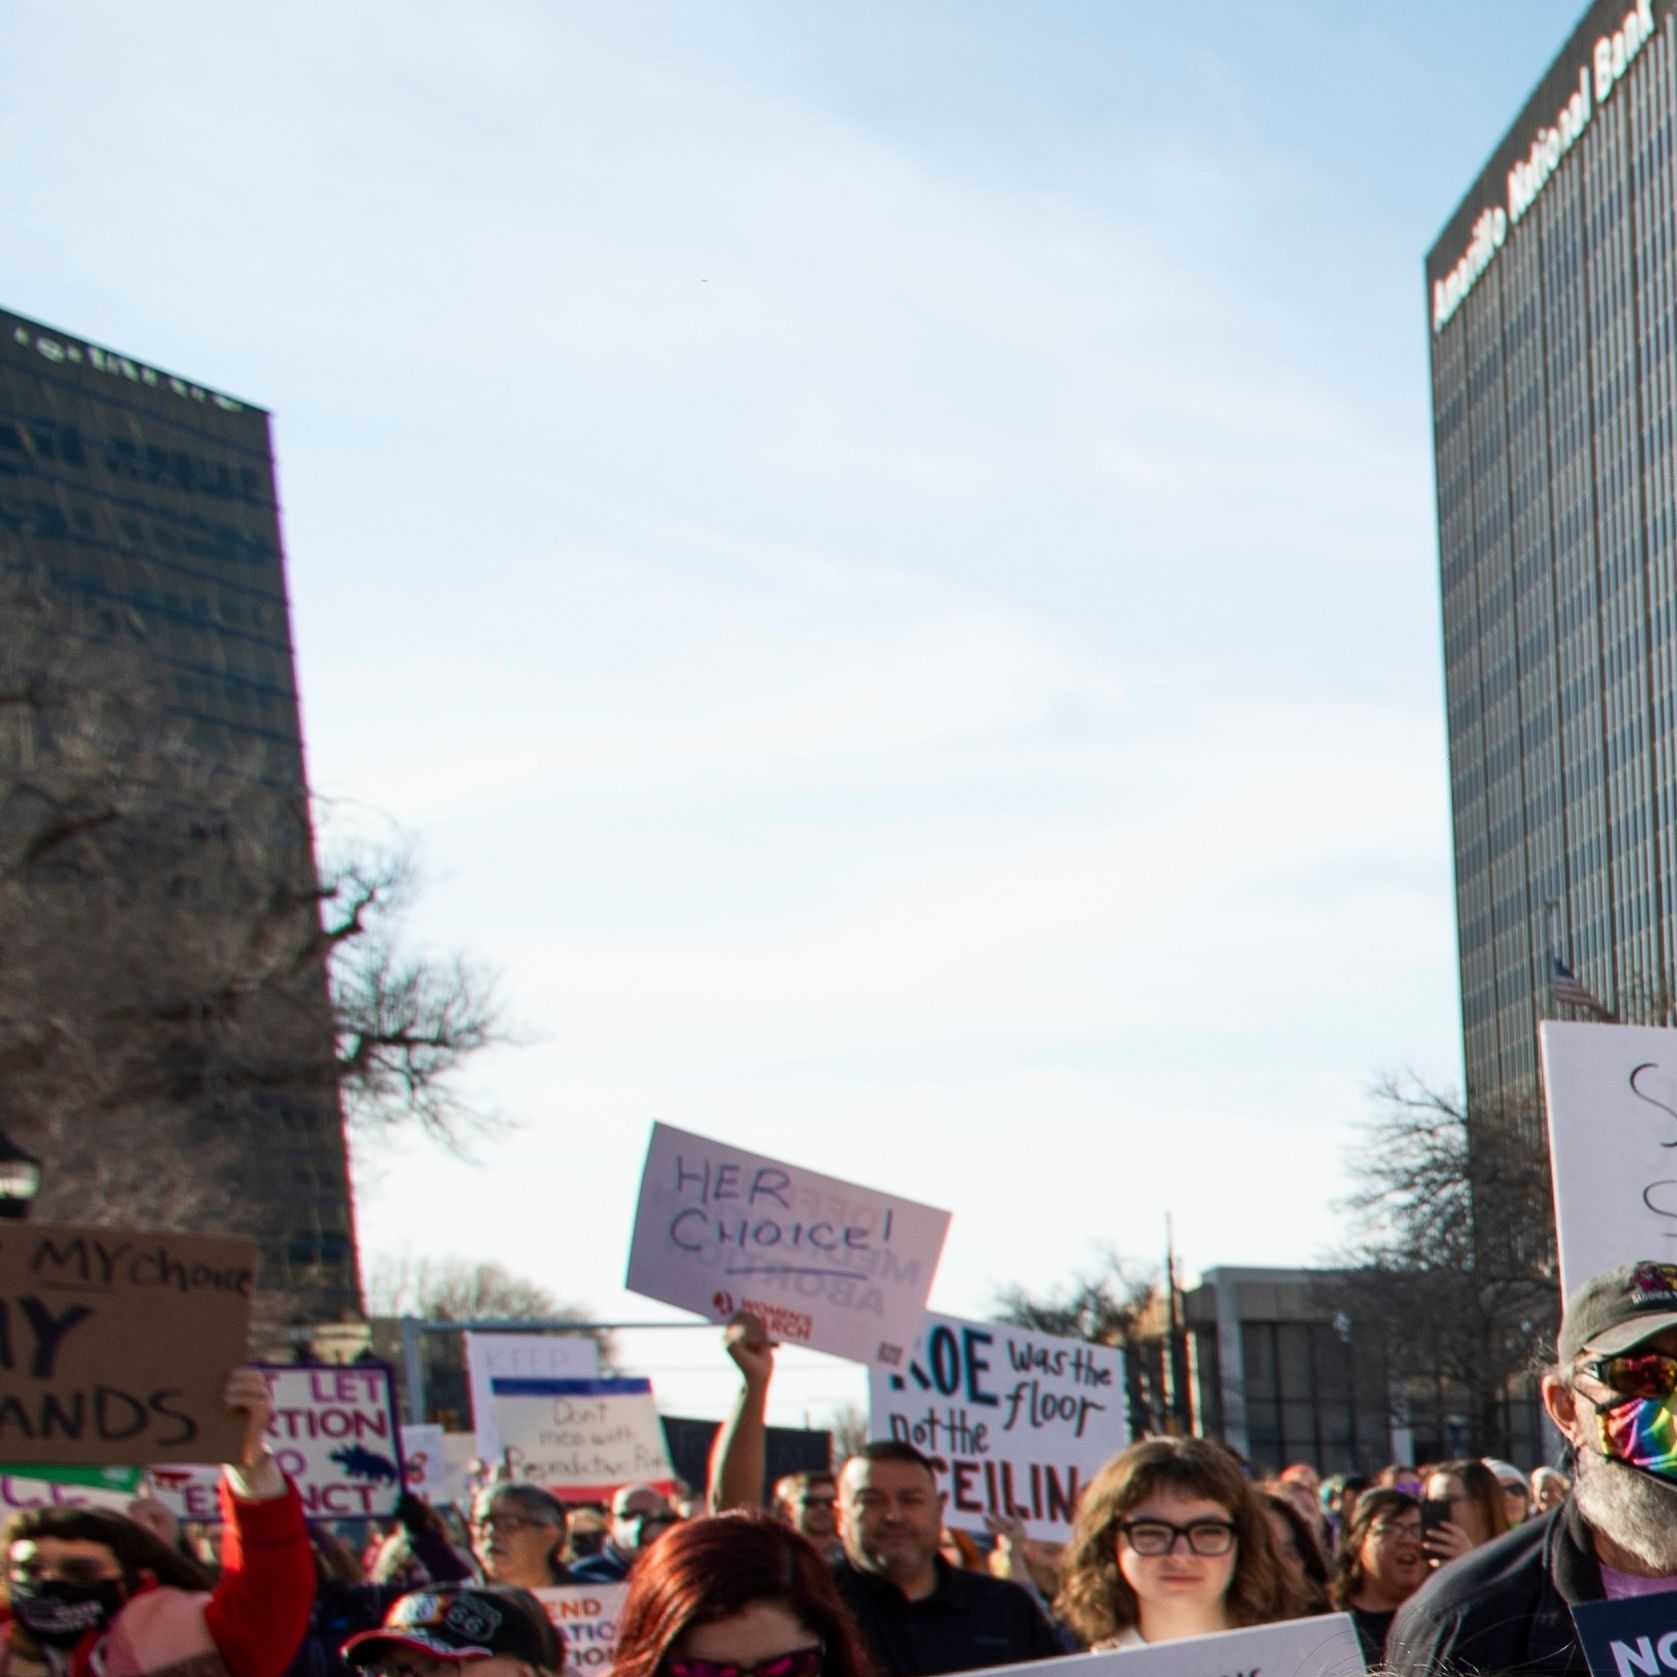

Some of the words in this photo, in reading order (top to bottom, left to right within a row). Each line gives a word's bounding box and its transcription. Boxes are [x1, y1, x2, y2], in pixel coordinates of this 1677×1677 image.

[1508, 64, 1592, 226] National
[677, 1155, 791, 1210] HER
[669, 1207, 894, 1252] CHOICE!
[31, 1237, 131, 1283] MY
[0, 1295, 95, 1379] Y
[310, 1369, 382, 1404] LET
[889, 1325, 999, 1407] OE
[1007, 1337, 1068, 1377] was
[1068, 1348, 1113, 1388] the
[0, 1384, 198, 1447] ANDS
[940, 1406, 991, 1455] the
[1001, 1379, 1106, 1438] floor
